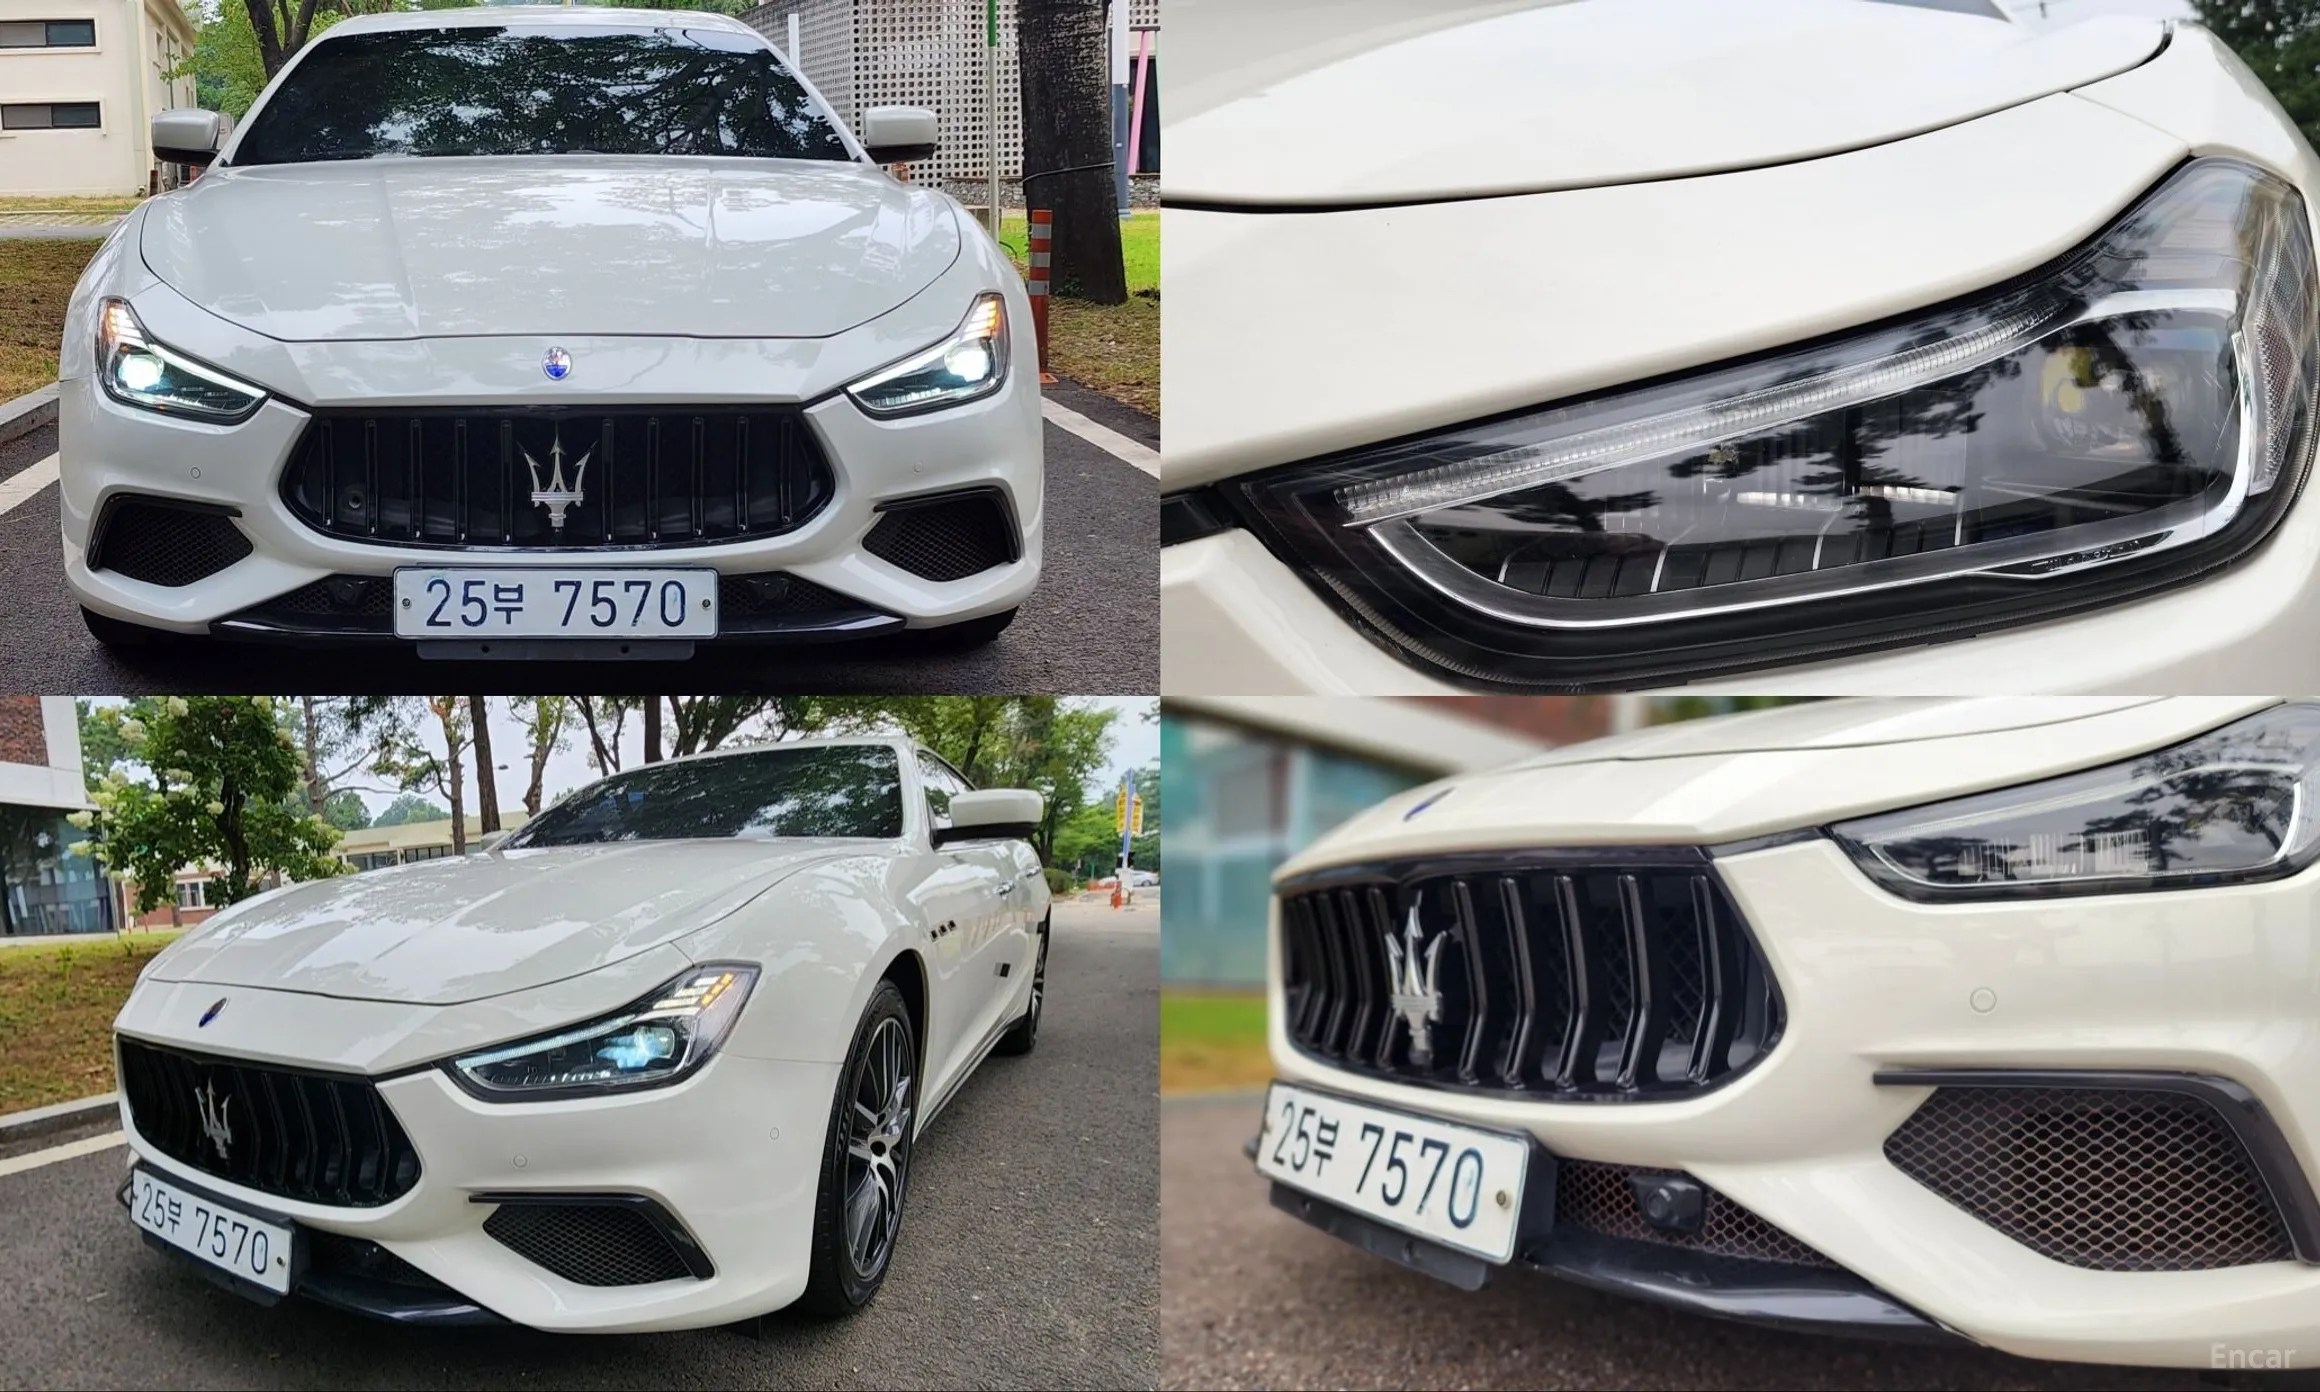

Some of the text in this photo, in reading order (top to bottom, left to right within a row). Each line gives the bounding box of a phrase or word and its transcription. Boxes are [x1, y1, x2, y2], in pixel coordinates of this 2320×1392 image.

[426, 578, 686, 627] 25부 7570
[1272, 1100, 1484, 1229] 25부 7570
[141, 1182, 269, 1275] 25부 7570
